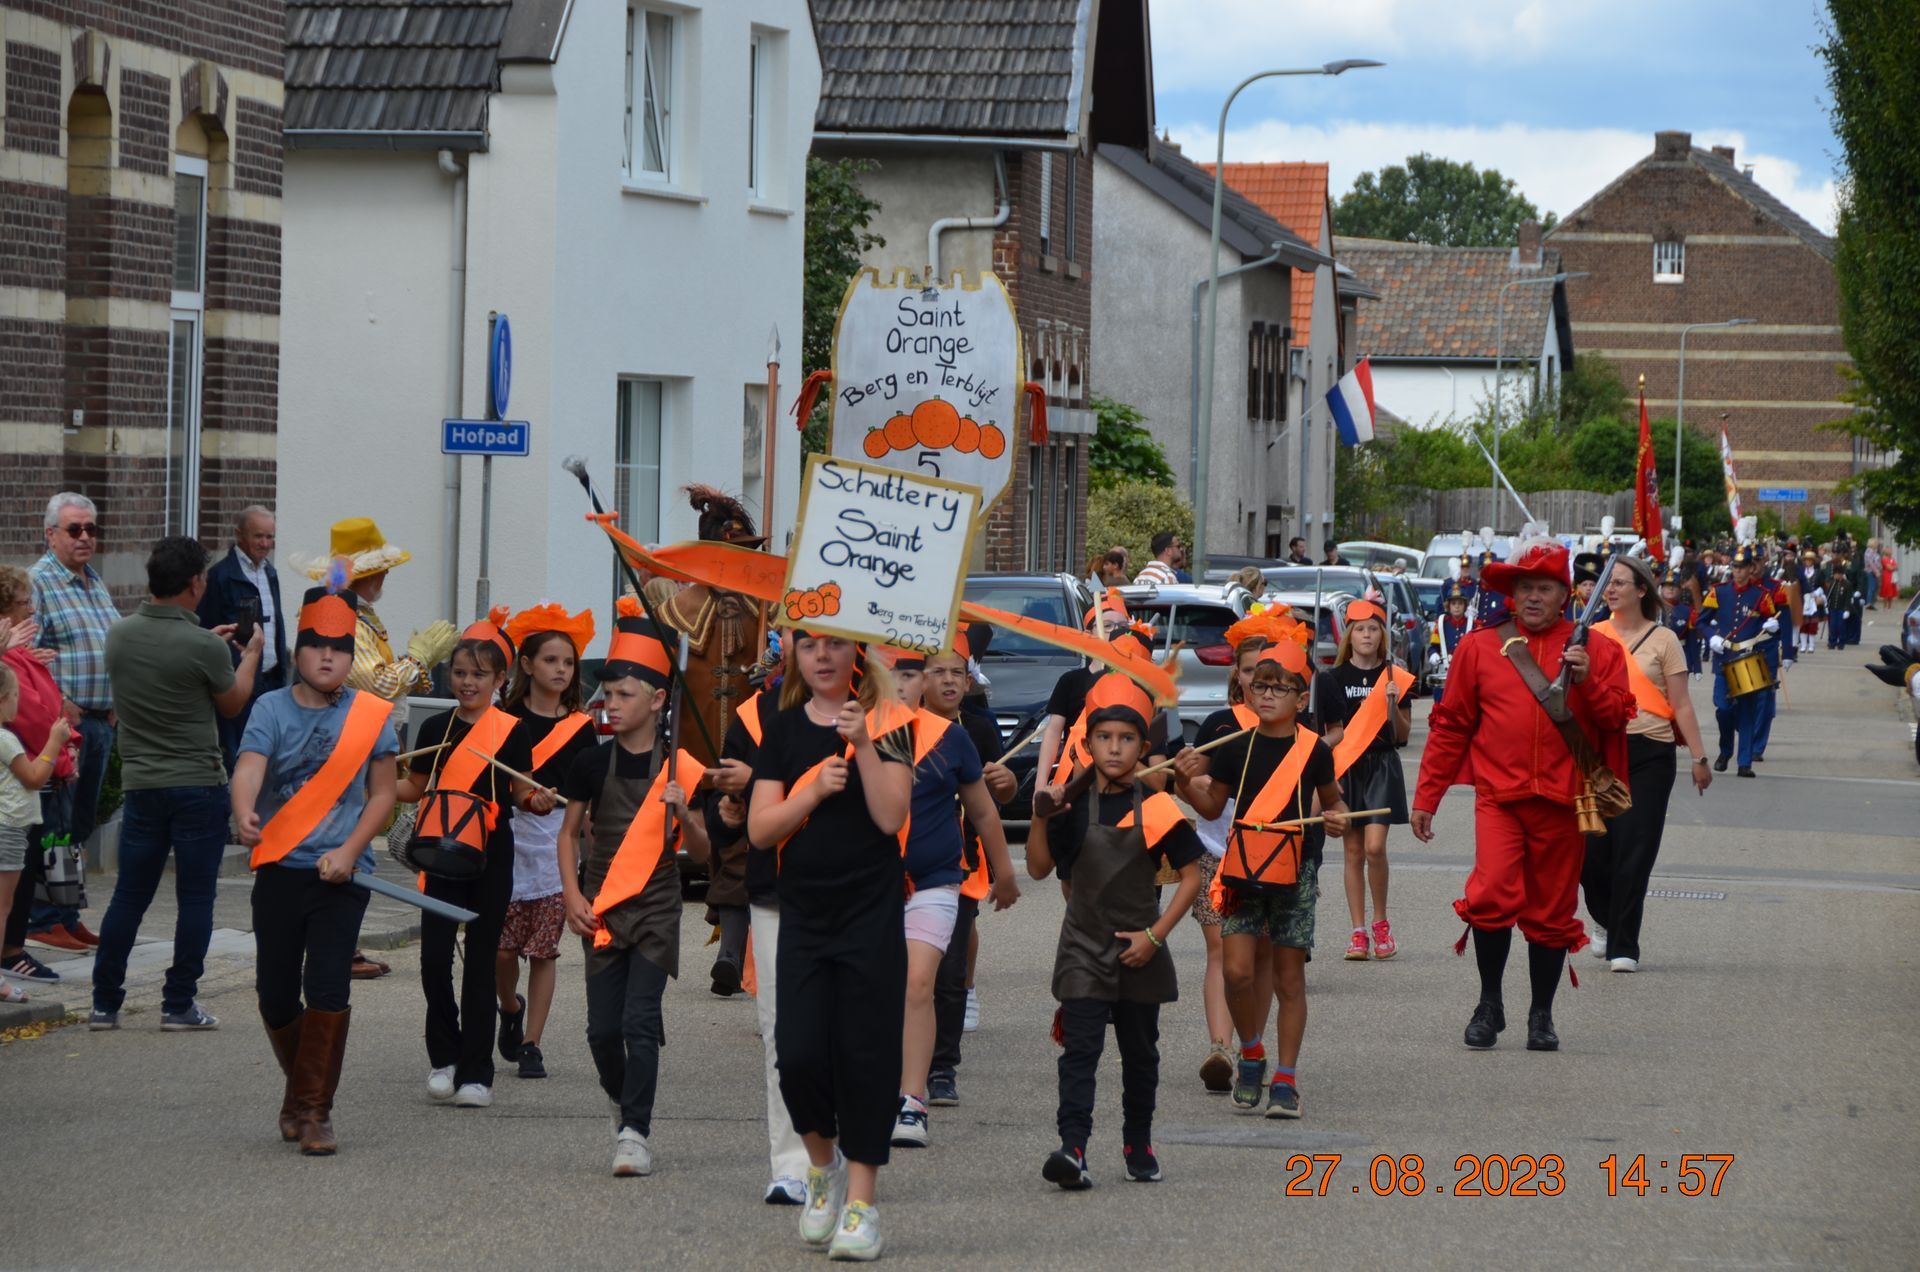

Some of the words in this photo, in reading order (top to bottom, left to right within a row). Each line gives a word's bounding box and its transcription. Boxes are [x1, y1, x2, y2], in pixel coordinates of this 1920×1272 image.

[897, 296, 966, 329] Saint
[886, 327, 975, 365] Orange
[839, 373, 899, 407] Berg
[906, 370, 928, 385] en
[452, 427, 518, 447] Hofpad
[917, 451, 942, 478] 5
[835, 508, 923, 552] Saint
[819, 540, 917, 588] Orange
[807, 598, 819, 613] 5
[867, 601, 895, 625] Berg
[899, 613, 913, 624] en
[884, 627, 942, 657] 2023
